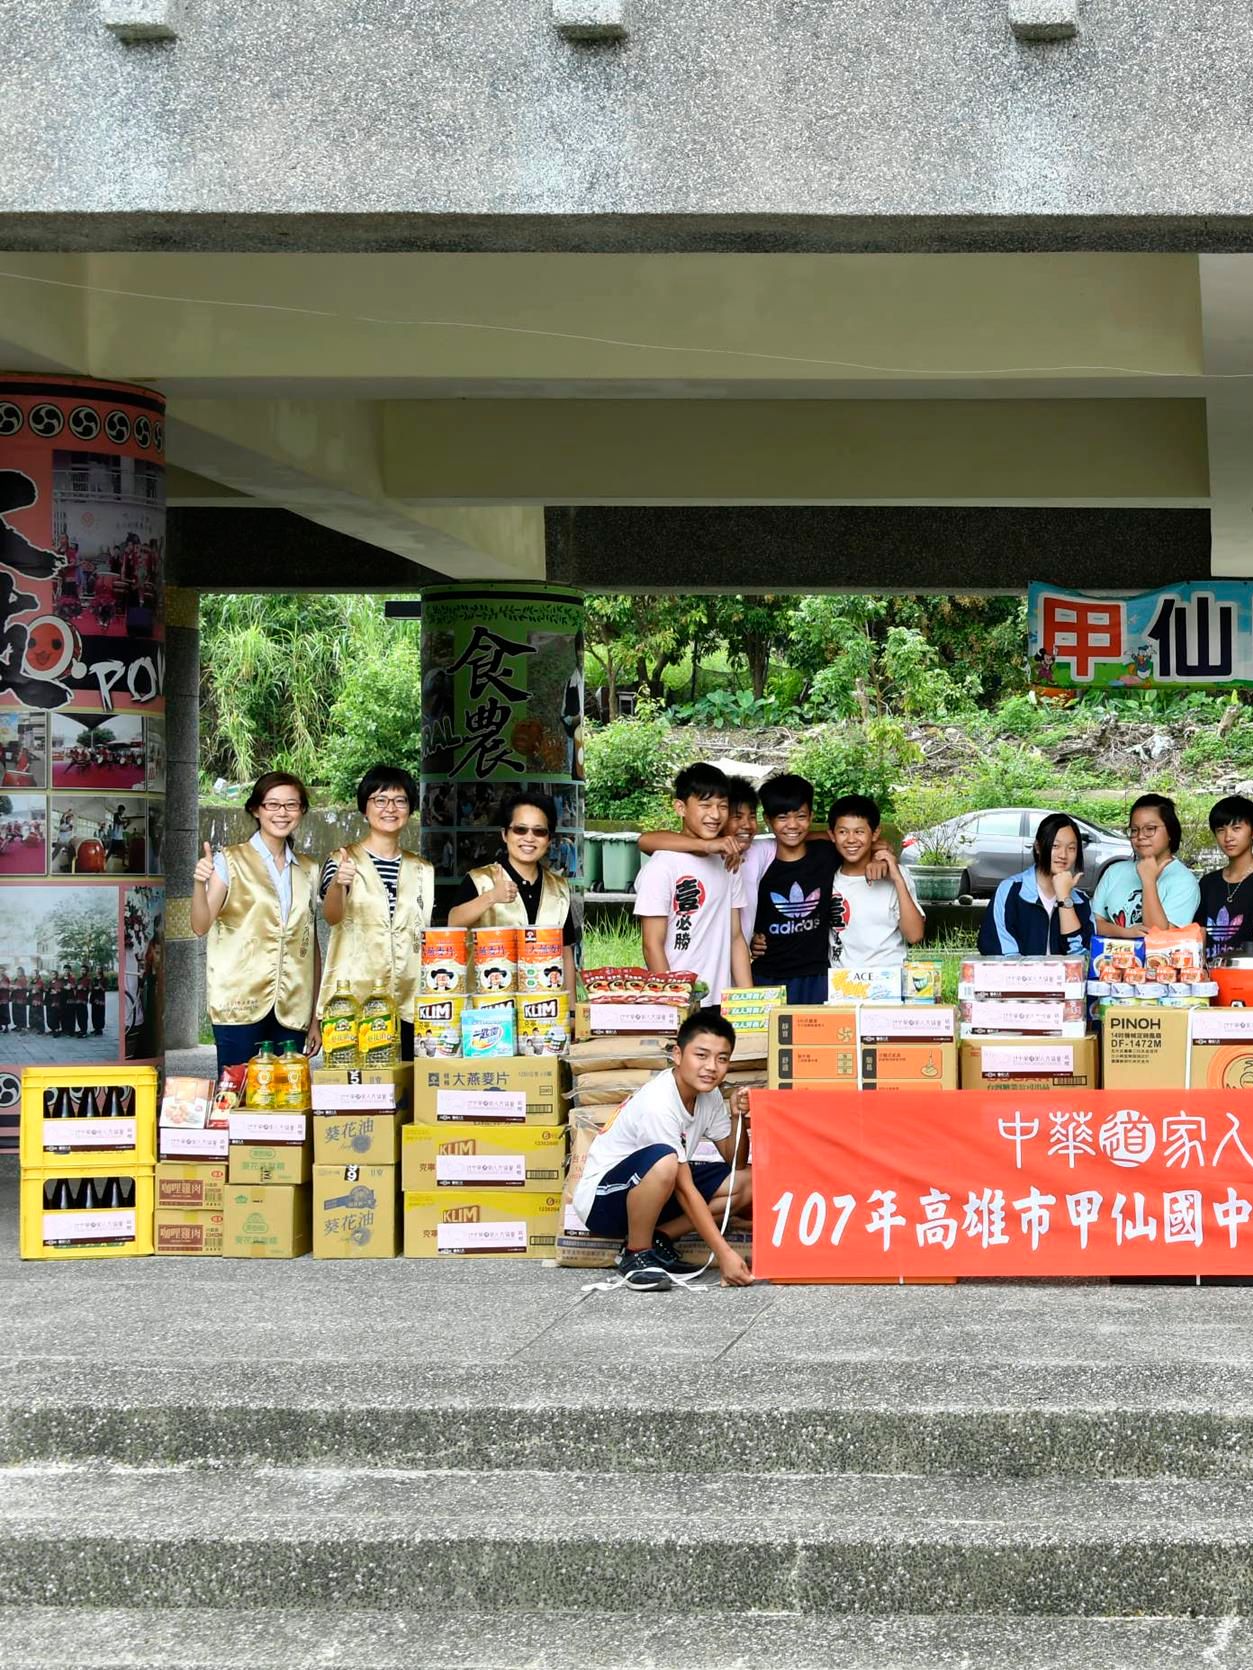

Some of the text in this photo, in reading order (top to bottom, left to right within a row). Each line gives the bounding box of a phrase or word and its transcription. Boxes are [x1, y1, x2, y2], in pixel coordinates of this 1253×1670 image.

[446, 625, 537, 778] 食農
[853, 972, 874, 981] ACE
[419, 1003, 450, 1019] KLIM
[525, 1002, 556, 1018] KLIM
[1110, 1018, 1161, 1029] PINOH
[1111, 1040, 1161, 1048] DF-1472M
[453, 1072, 510, 1086] 大燕麥片
[325, 1117, 374, 1143] 葵花油
[439, 1141, 474, 1155] KLIM
[443, 1207, 479, 1222] KLIM
[324, 1211, 374, 1236] 葵花油
